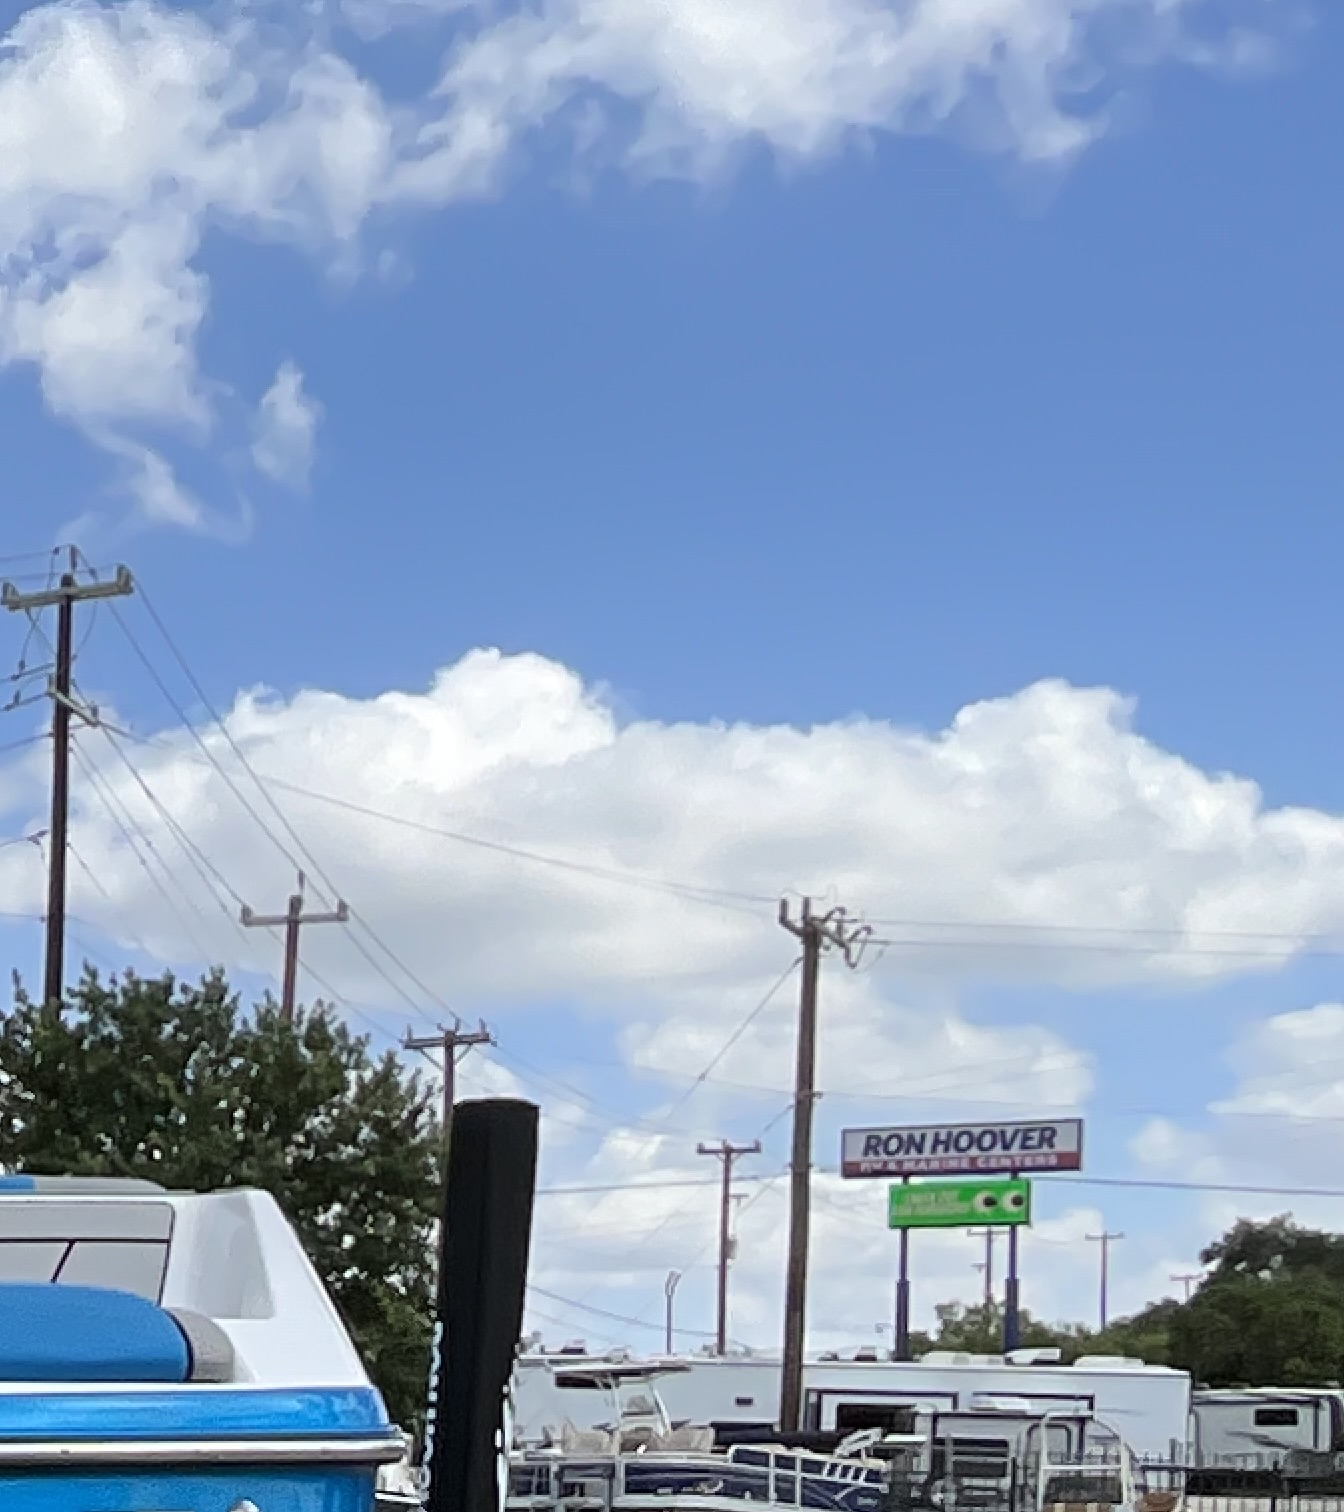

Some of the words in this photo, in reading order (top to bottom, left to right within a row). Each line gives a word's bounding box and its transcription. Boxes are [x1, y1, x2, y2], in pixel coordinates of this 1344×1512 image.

[862, 1132, 926, 1158] RON
[930, 1126, 1058, 1155] HOOVER
[904, 1156, 970, 1171] MARINE
[976, 1154, 1058, 1168] CENTERS
